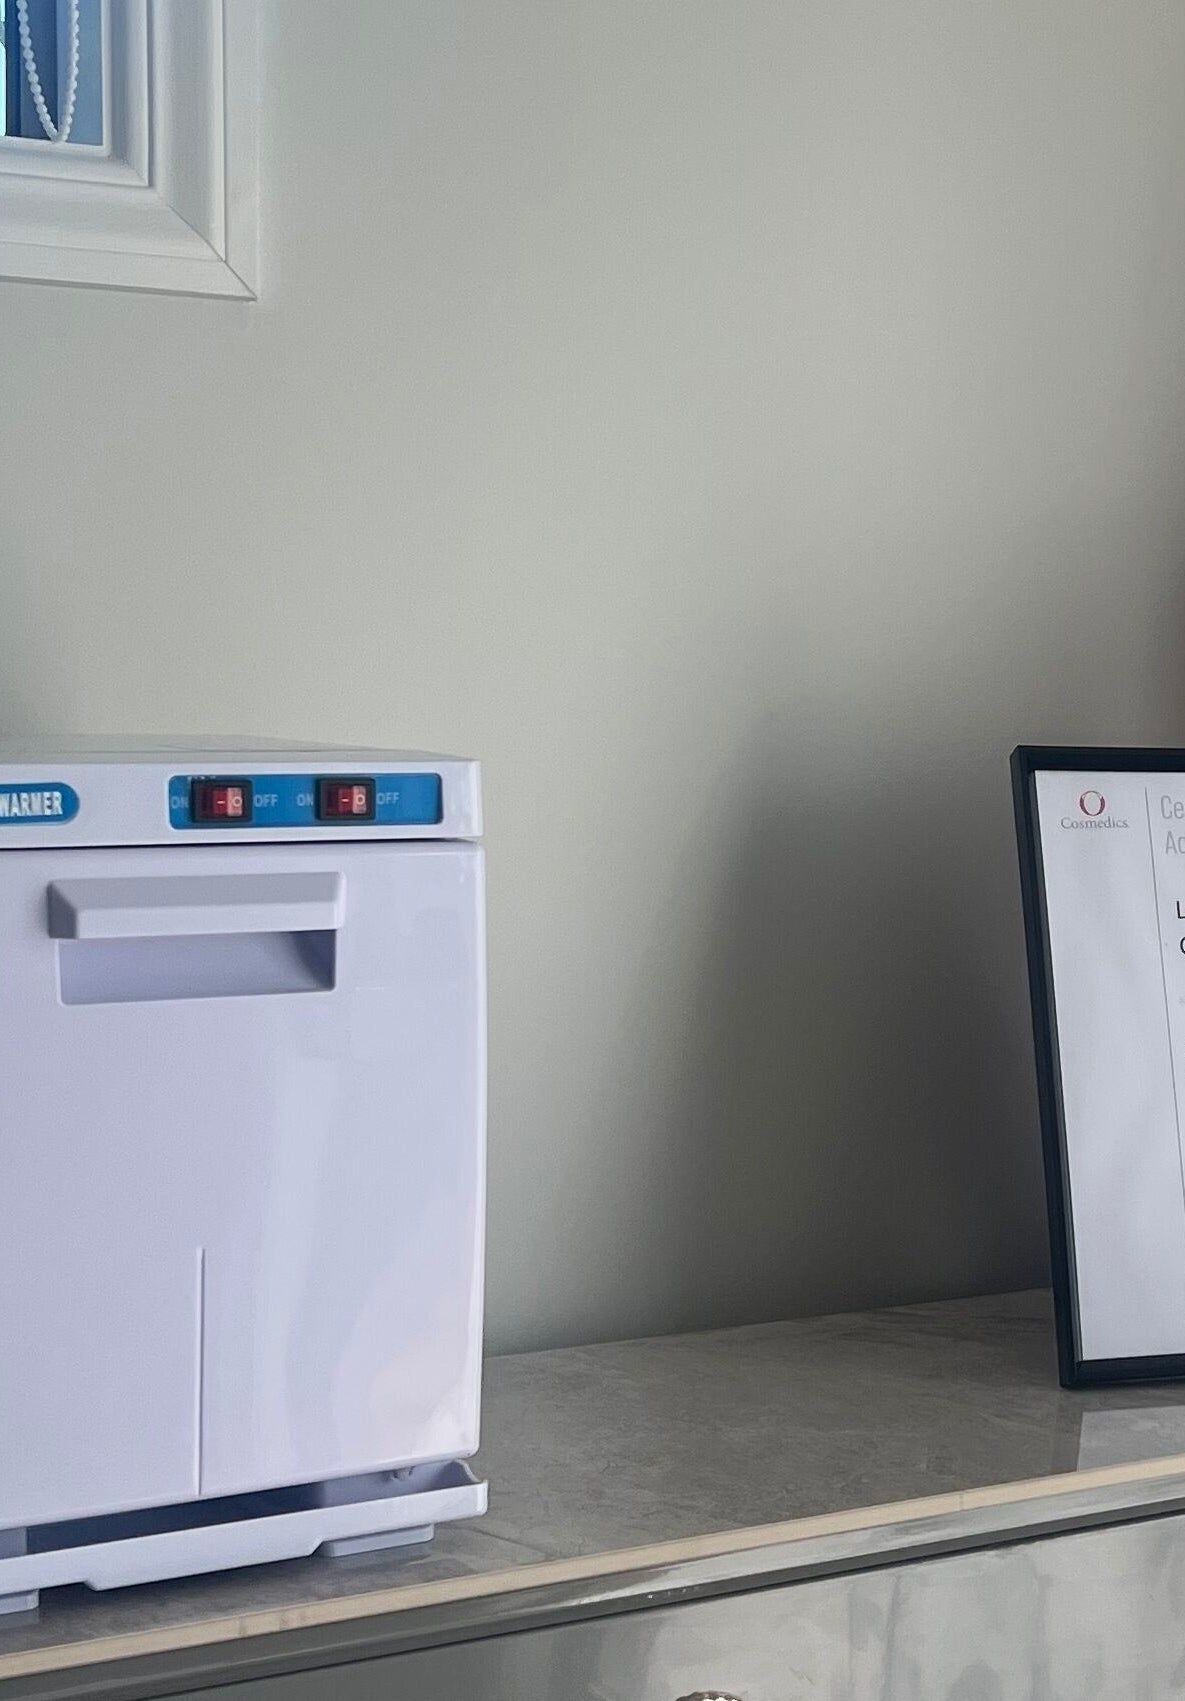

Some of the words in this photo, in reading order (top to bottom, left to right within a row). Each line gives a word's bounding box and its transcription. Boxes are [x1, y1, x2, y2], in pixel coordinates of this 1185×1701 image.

[0, 791, 63, 817] WARMER
[253, 794, 279, 807] OFF
[296, 793, 314, 807] ON
[375, 792, 400, 805] OFF
[1060, 815, 1129, 830] Cosmedics
